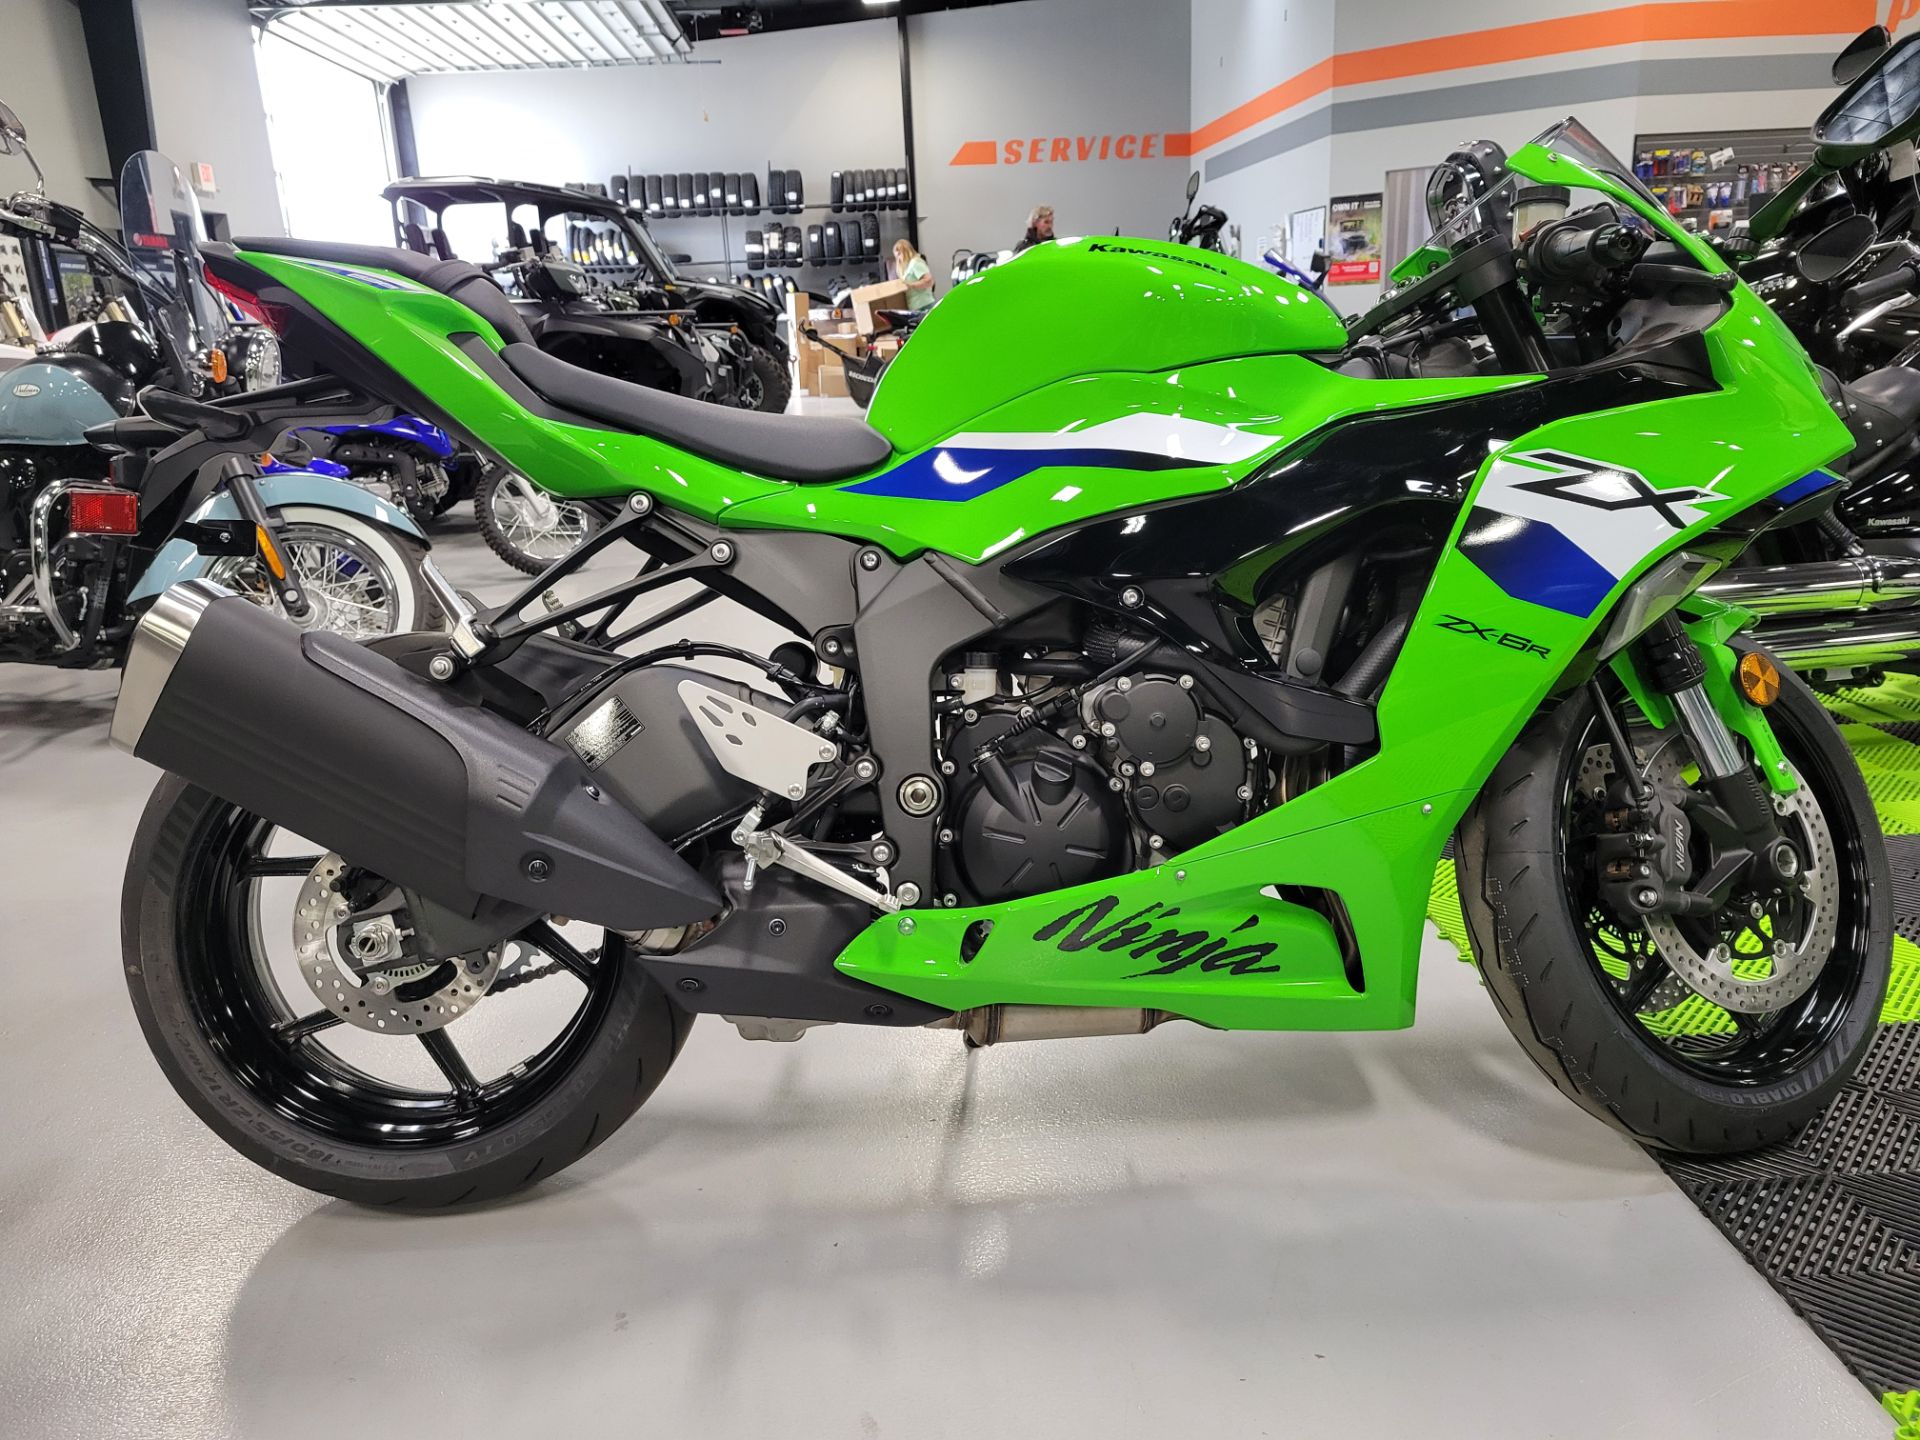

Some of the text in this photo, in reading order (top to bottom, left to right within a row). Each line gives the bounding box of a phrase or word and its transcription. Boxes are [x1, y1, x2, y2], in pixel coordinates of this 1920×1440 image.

[1003, 132, 1159, 165] SERVICE
[1088, 243, 1227, 275] Kawasaki
[1505, 452, 1714, 530] ZX
[1867, 516, 1910, 526] Kawasaki
[1433, 614, 1551, 660] ZX-6R
[1032, 895, 1281, 979] Ninja
[1730, 1083, 1803, 1105] DIABLO
